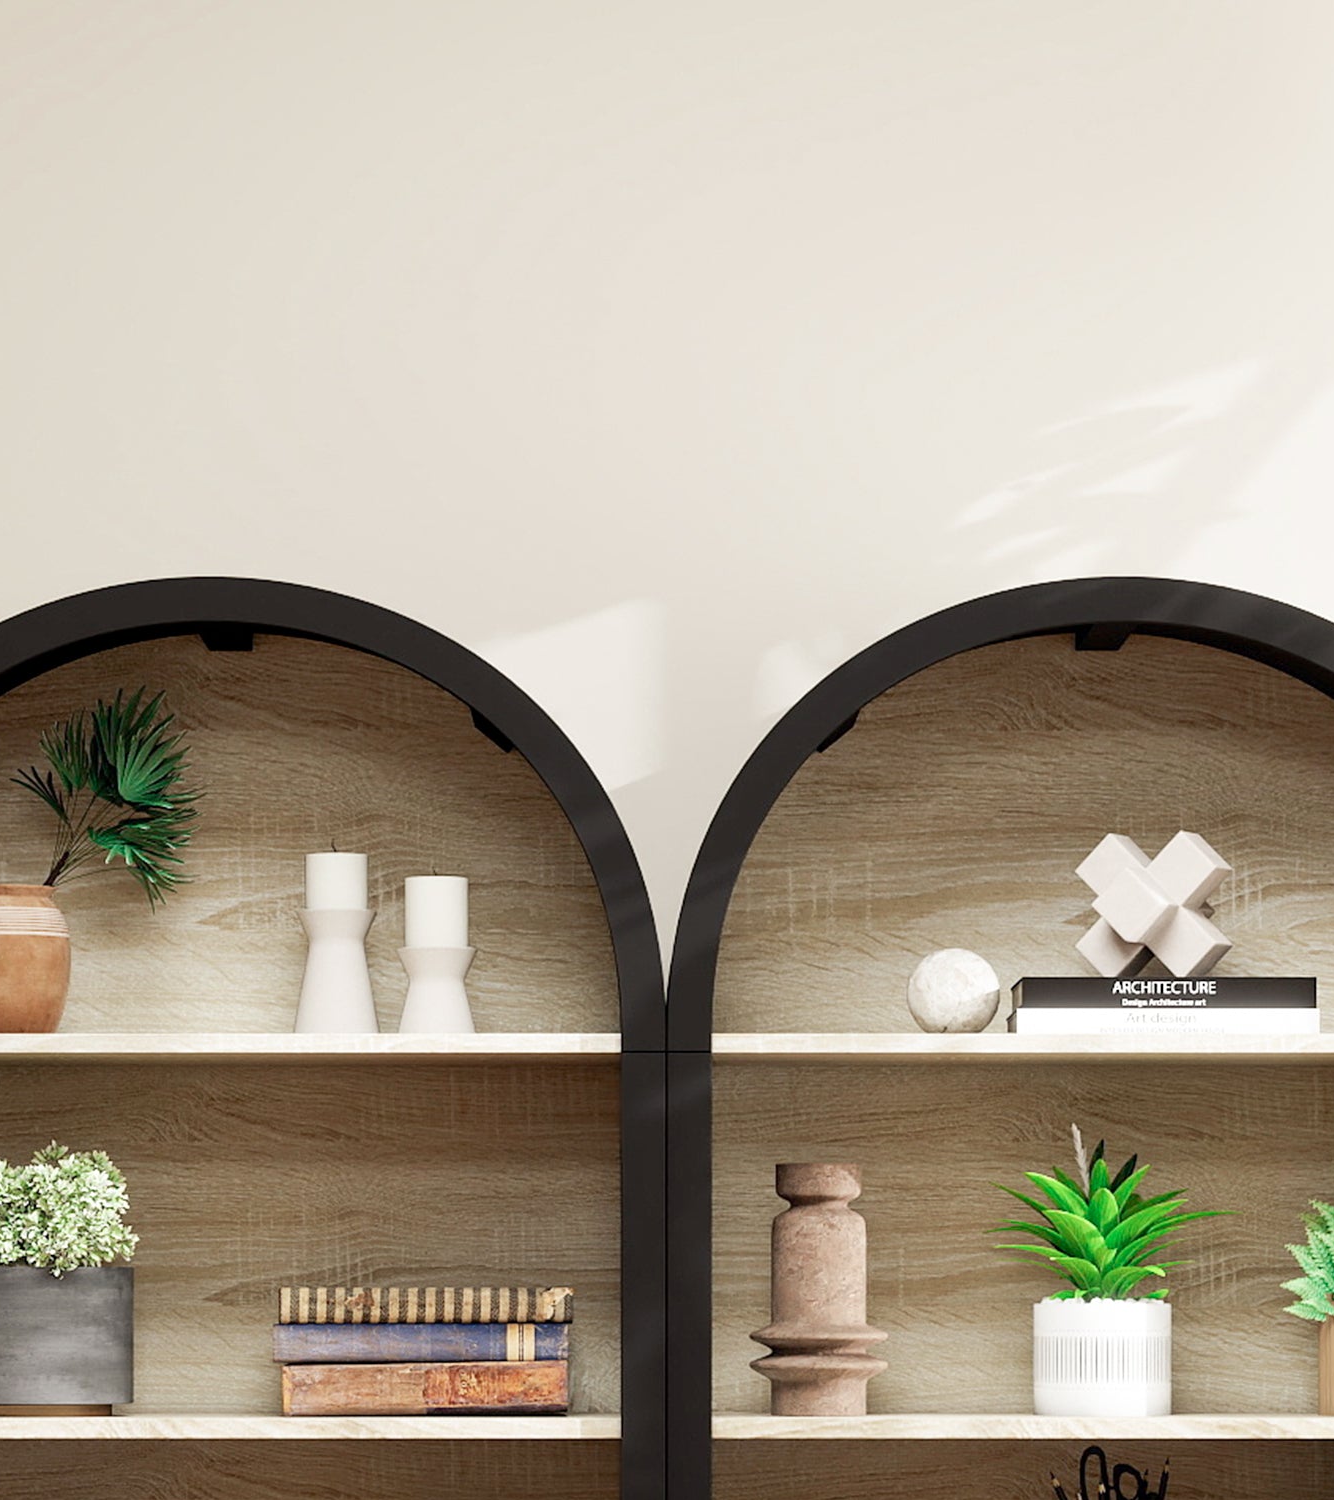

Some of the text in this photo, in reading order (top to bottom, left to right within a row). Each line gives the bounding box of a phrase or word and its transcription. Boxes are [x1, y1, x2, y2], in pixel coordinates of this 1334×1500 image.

[1112, 981, 1217, 995] ARCHITECTURE
[1122, 999, 1148, 1007] Design
[1127, 1012, 1197, 1025] Art design
